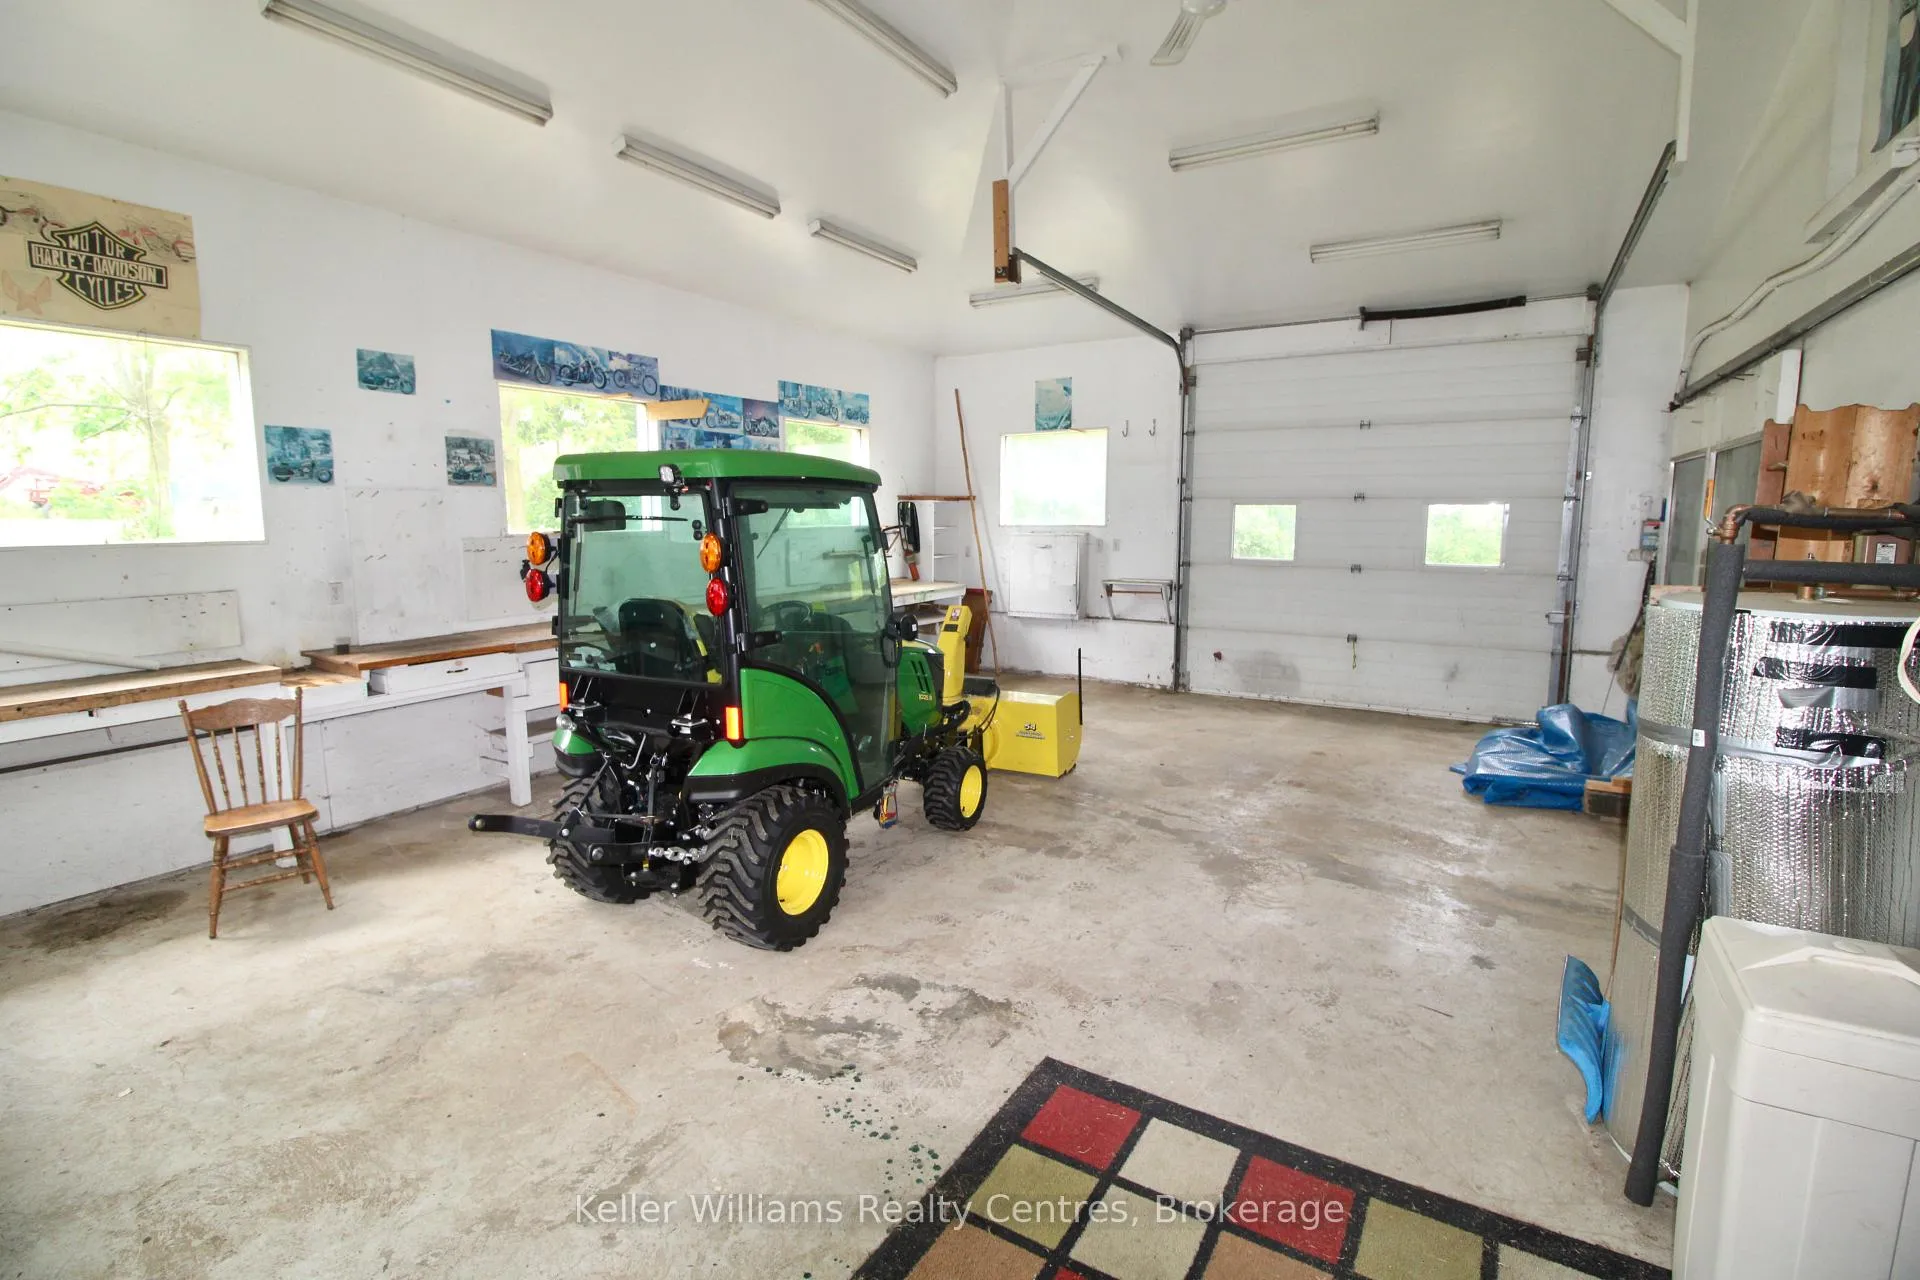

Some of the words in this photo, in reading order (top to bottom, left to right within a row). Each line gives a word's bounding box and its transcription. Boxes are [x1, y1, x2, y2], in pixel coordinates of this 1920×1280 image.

[68, 229, 126, 259] MOTOR
[34, 246, 157, 283] HARLEY-DAVIDSON
[75, 274, 135, 306] CYCLES
